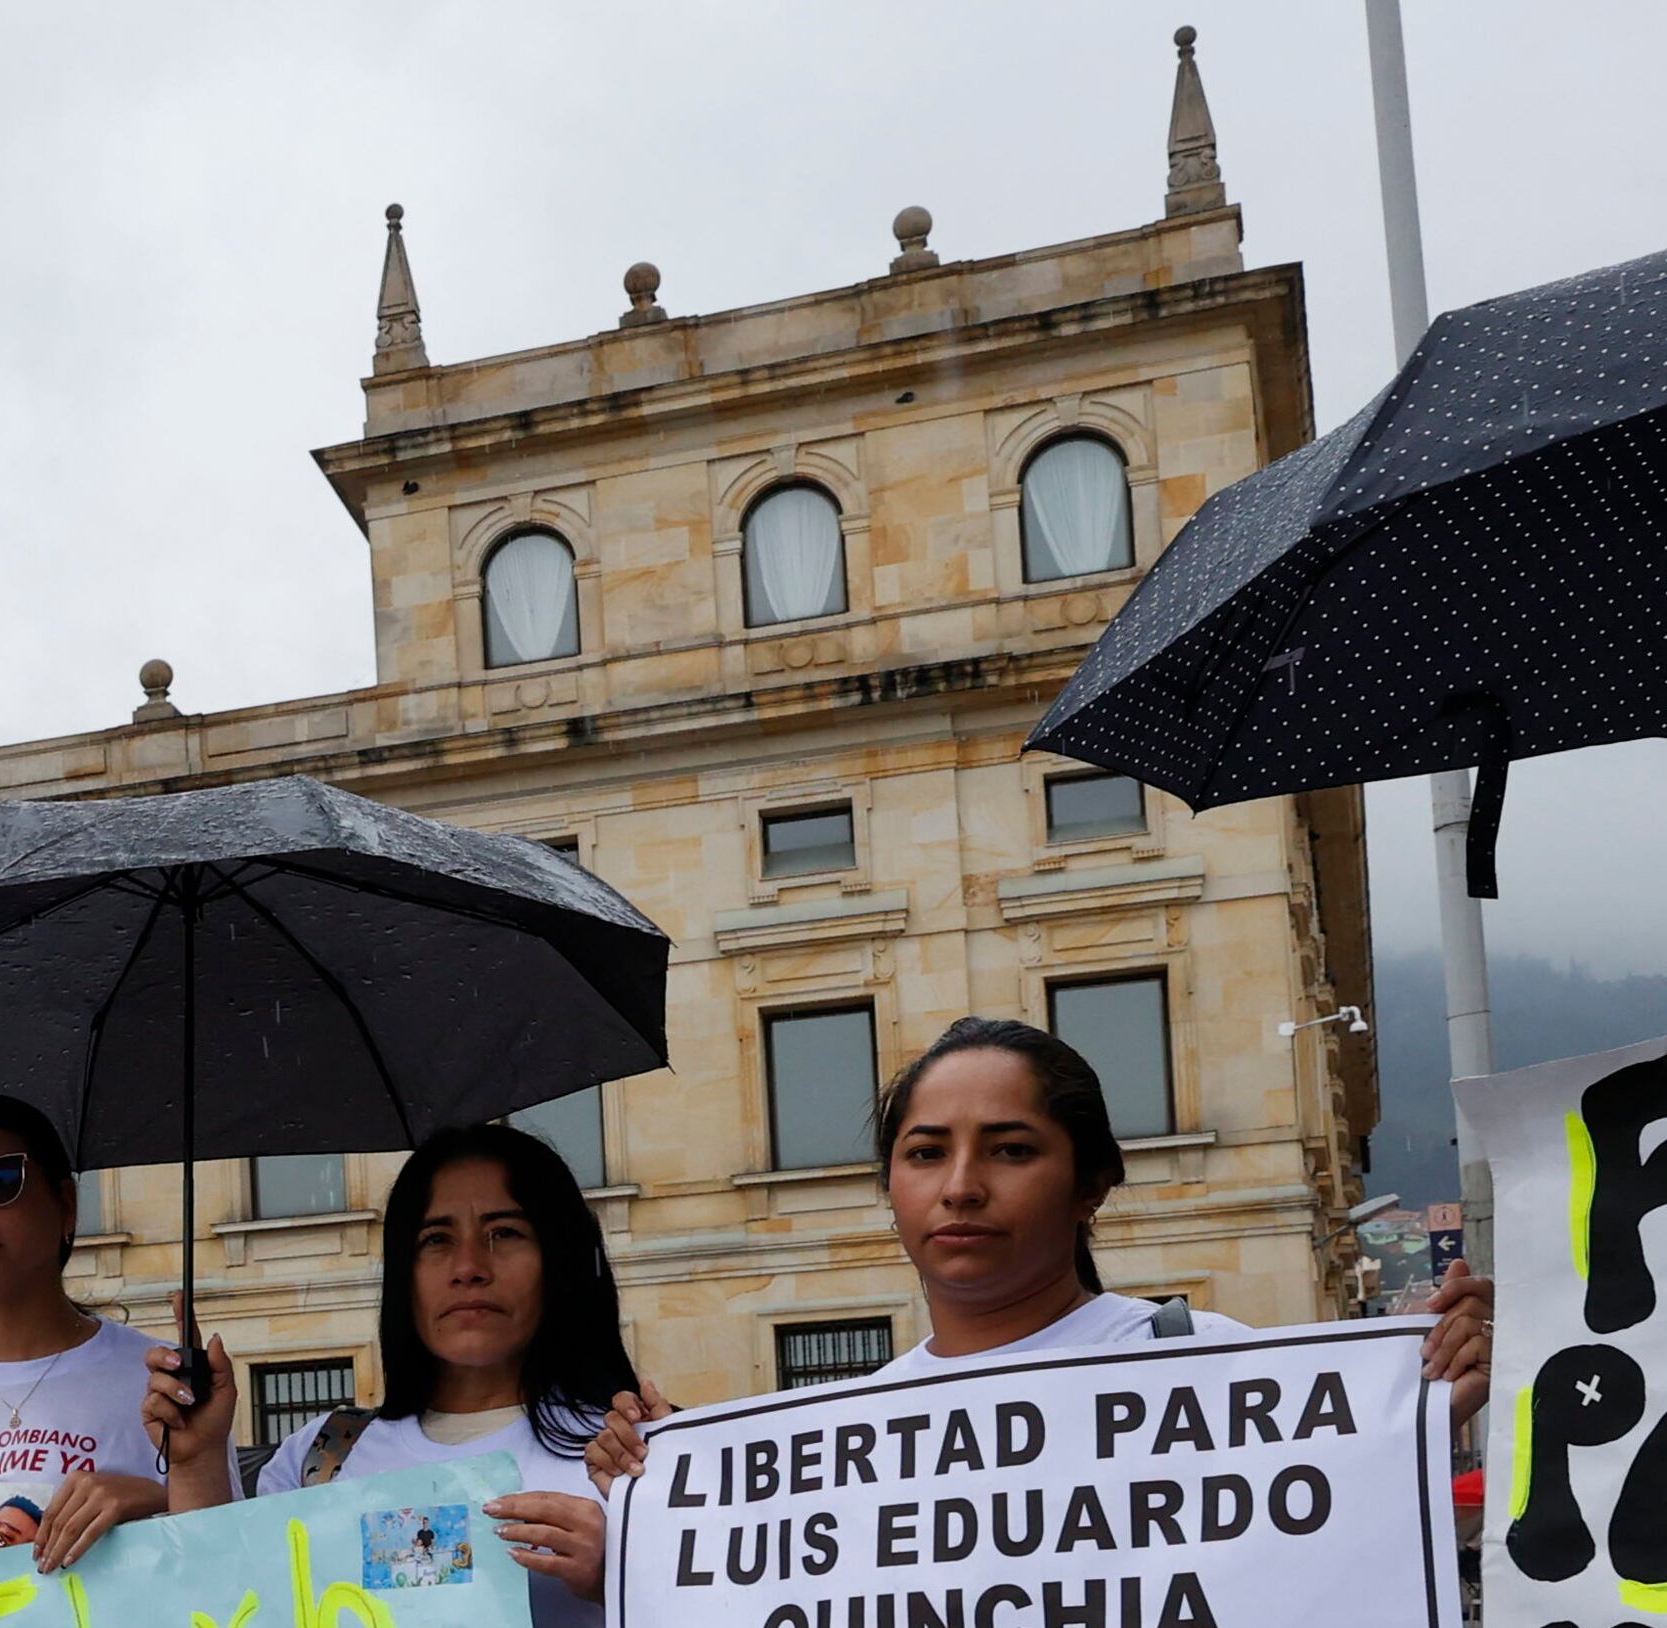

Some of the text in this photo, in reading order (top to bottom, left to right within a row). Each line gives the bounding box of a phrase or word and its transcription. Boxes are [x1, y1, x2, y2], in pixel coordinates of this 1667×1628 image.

[668, 1372, 1357, 1509] LIBERTAD PARA
[676, 1465, 1332, 1588] LUIS EDUARDO
